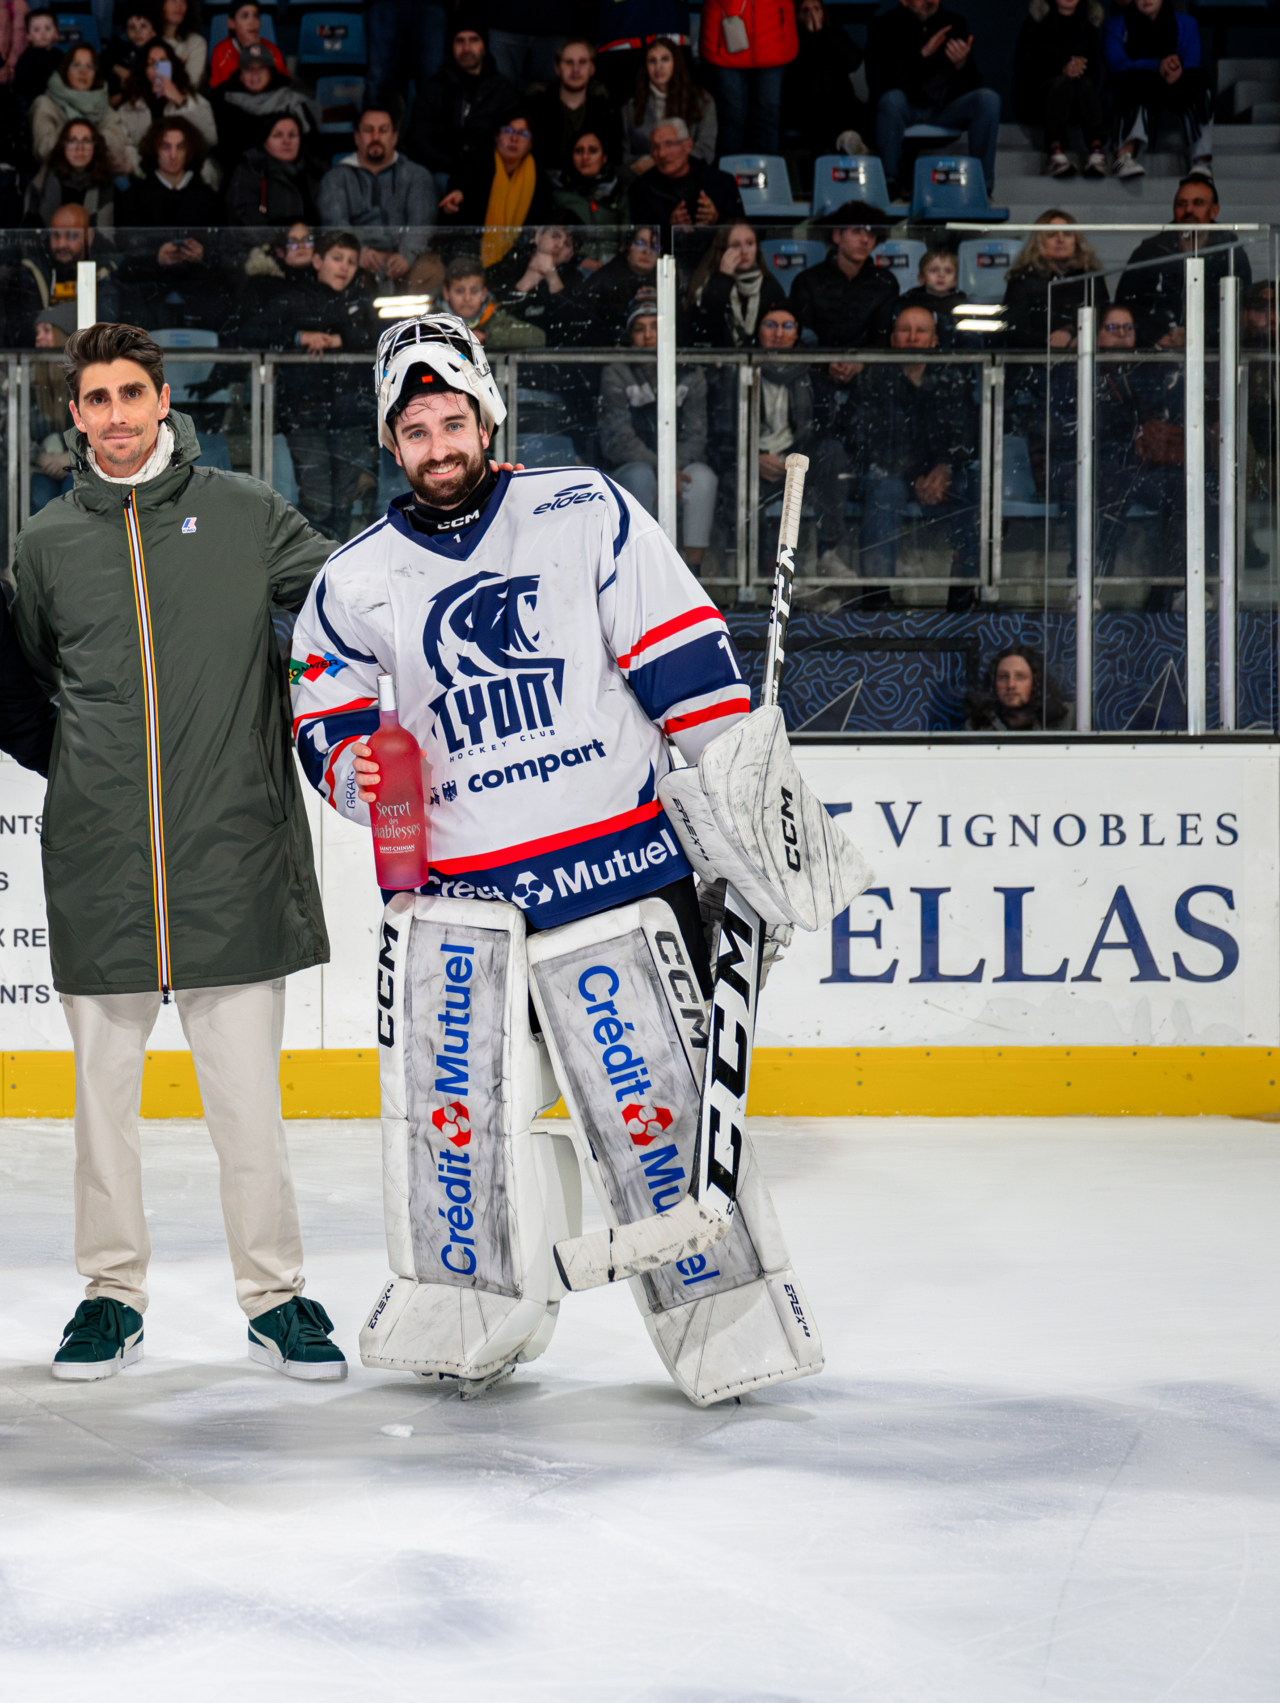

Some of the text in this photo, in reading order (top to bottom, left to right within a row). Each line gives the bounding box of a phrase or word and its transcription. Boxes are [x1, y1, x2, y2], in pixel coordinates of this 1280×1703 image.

[437, 509, 480, 531] CCM
[453, 533, 462, 544] 1
[306, 720, 331, 755] 1
[439, 672, 555, 755] LYON
[449, 729, 556, 763] HOCKEY CLUB
[467, 738, 607, 793] compart
[375, 801, 411, 820] Secret
[388, 817, 399, 825] des
[780, 785, 802, 873] CCM
[553, 829, 679, 898] Mutuel
[377, 922, 401, 1049] CCM
[653, 929, 710, 1049] CCM
[706, 906, 754, 1202] CCM
[434, 943, 477, 1277] Crédit Mutuel
[578, 965, 720, 1286] Crédit Muel
